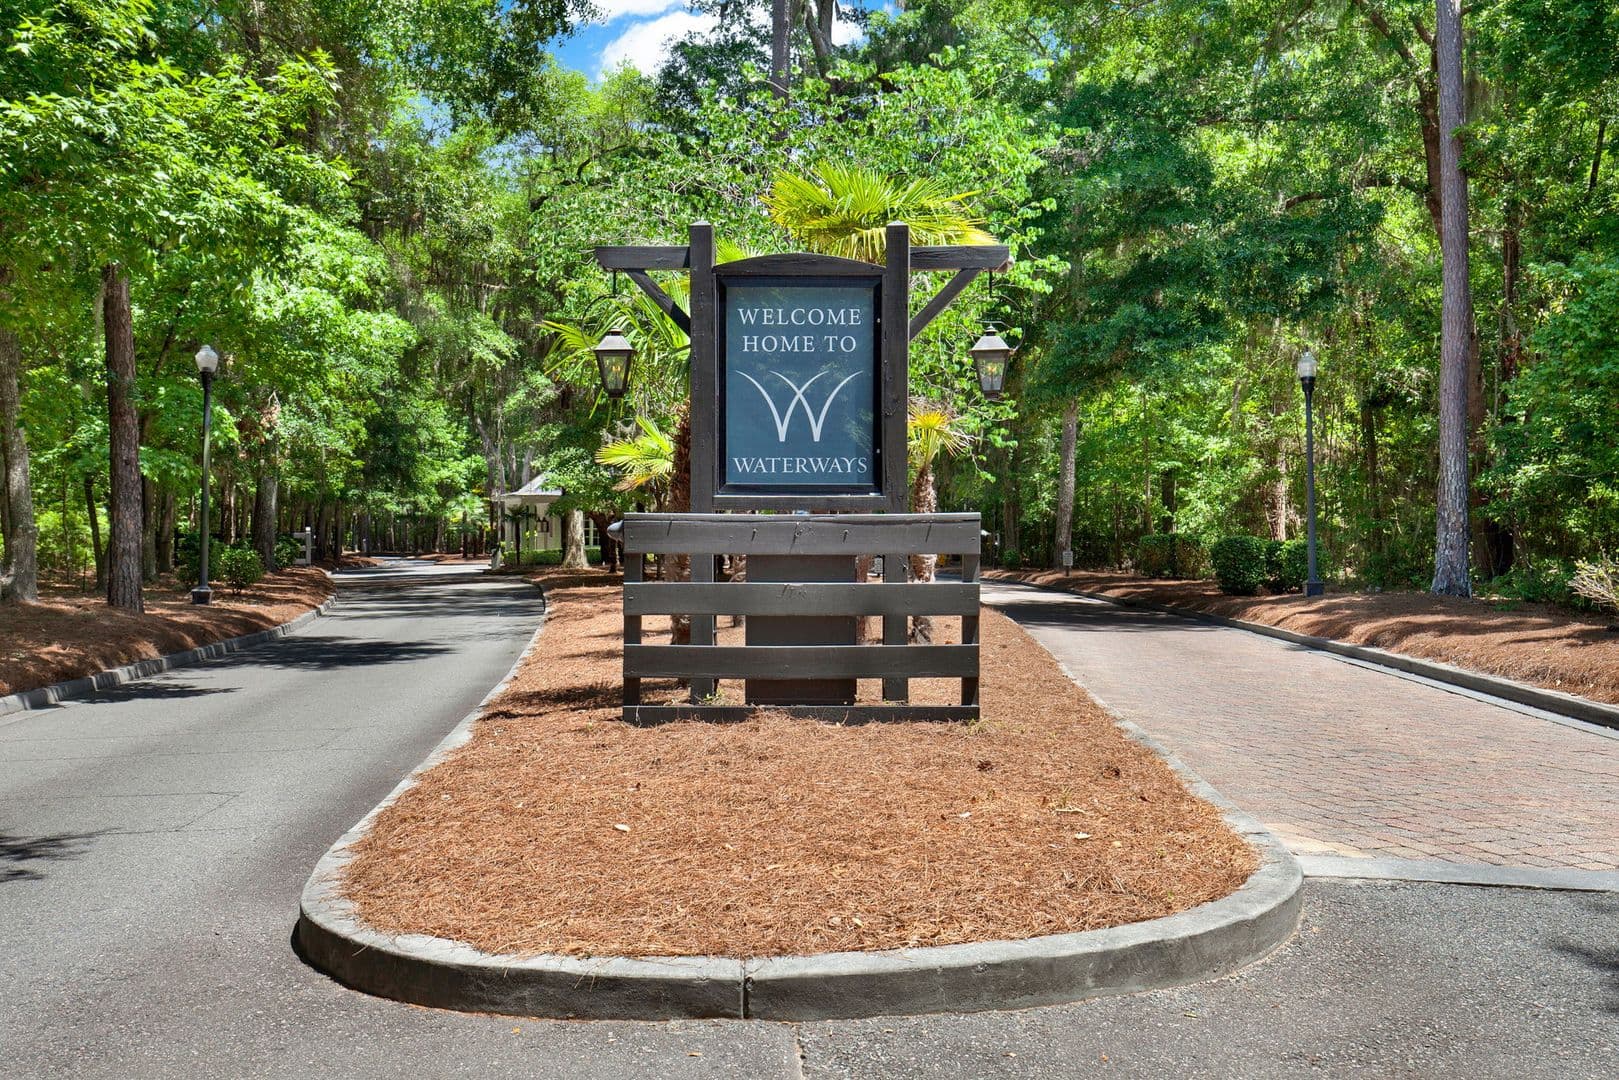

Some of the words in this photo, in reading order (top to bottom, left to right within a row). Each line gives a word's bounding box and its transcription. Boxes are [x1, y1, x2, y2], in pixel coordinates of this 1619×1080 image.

[737, 308, 862, 326] WELCOME
[742, 335, 815, 353] HOME
[823, 335, 857, 353] TO
[733, 457, 867, 473] WATERWAYS
